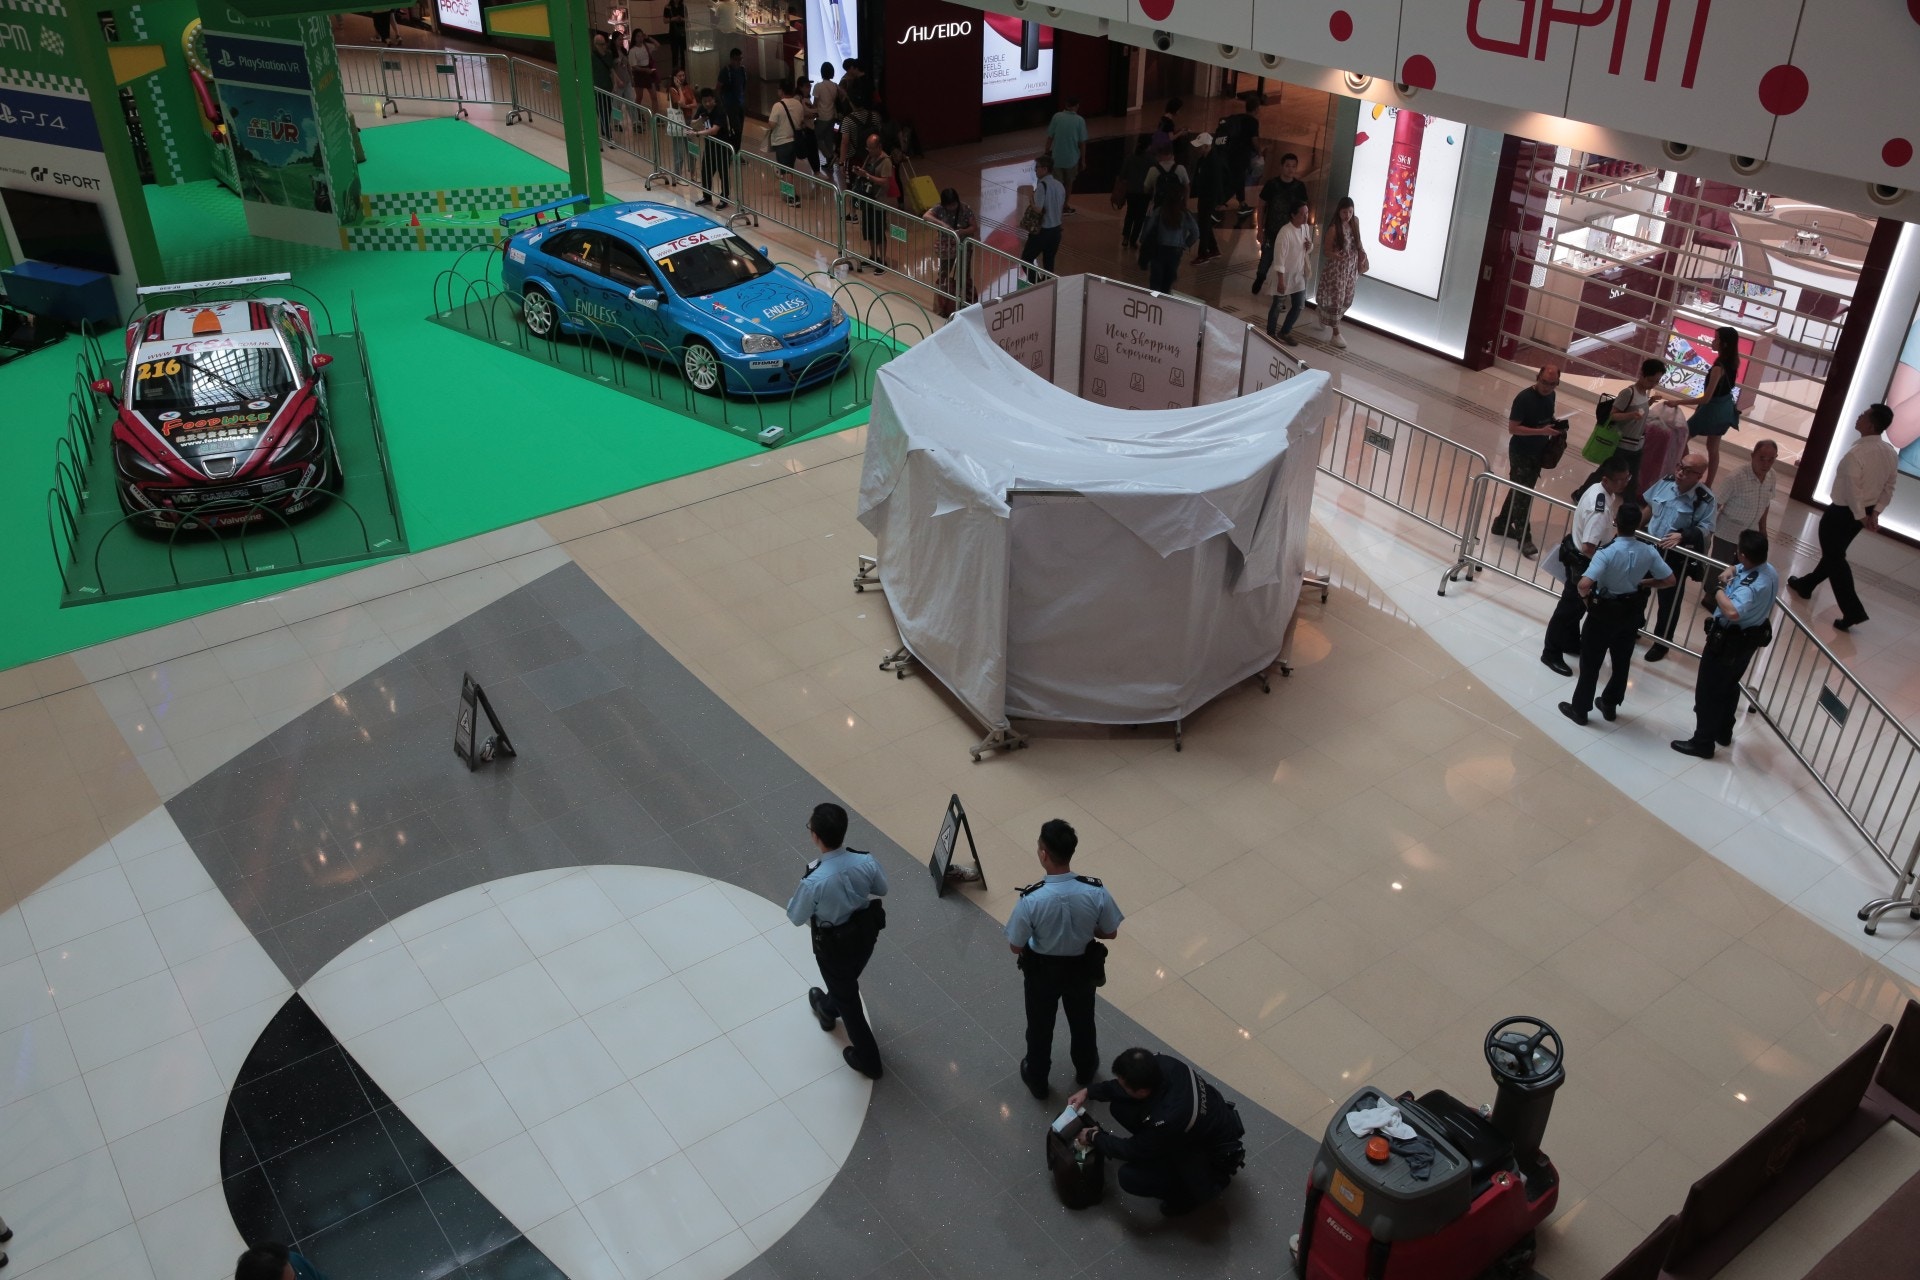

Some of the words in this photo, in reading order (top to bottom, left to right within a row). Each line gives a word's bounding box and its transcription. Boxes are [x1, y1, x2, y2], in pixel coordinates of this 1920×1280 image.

[897, 21, 972, 45] SHISEIDO
[238, 55, 288, 71] PlayStation
[287, 62, 300, 73] VR
[19, 109, 66, 130] PS4
[270, 121, 299, 143] VR
[53, 172, 101, 190] SPORT
[582, 242, 592, 259] 7
[658, 257, 675, 273] 7
[575, 298, 617, 324] ENDLESS
[762, 297, 805, 319] ENDLESS
[1105, 322, 1128, 339] New
[1130, 329, 1180, 358] Shopping
[1115, 342, 1162, 364] Experience
[137, 358, 182, 381] 216
[1326, 1216, 1353, 1241] Hako
